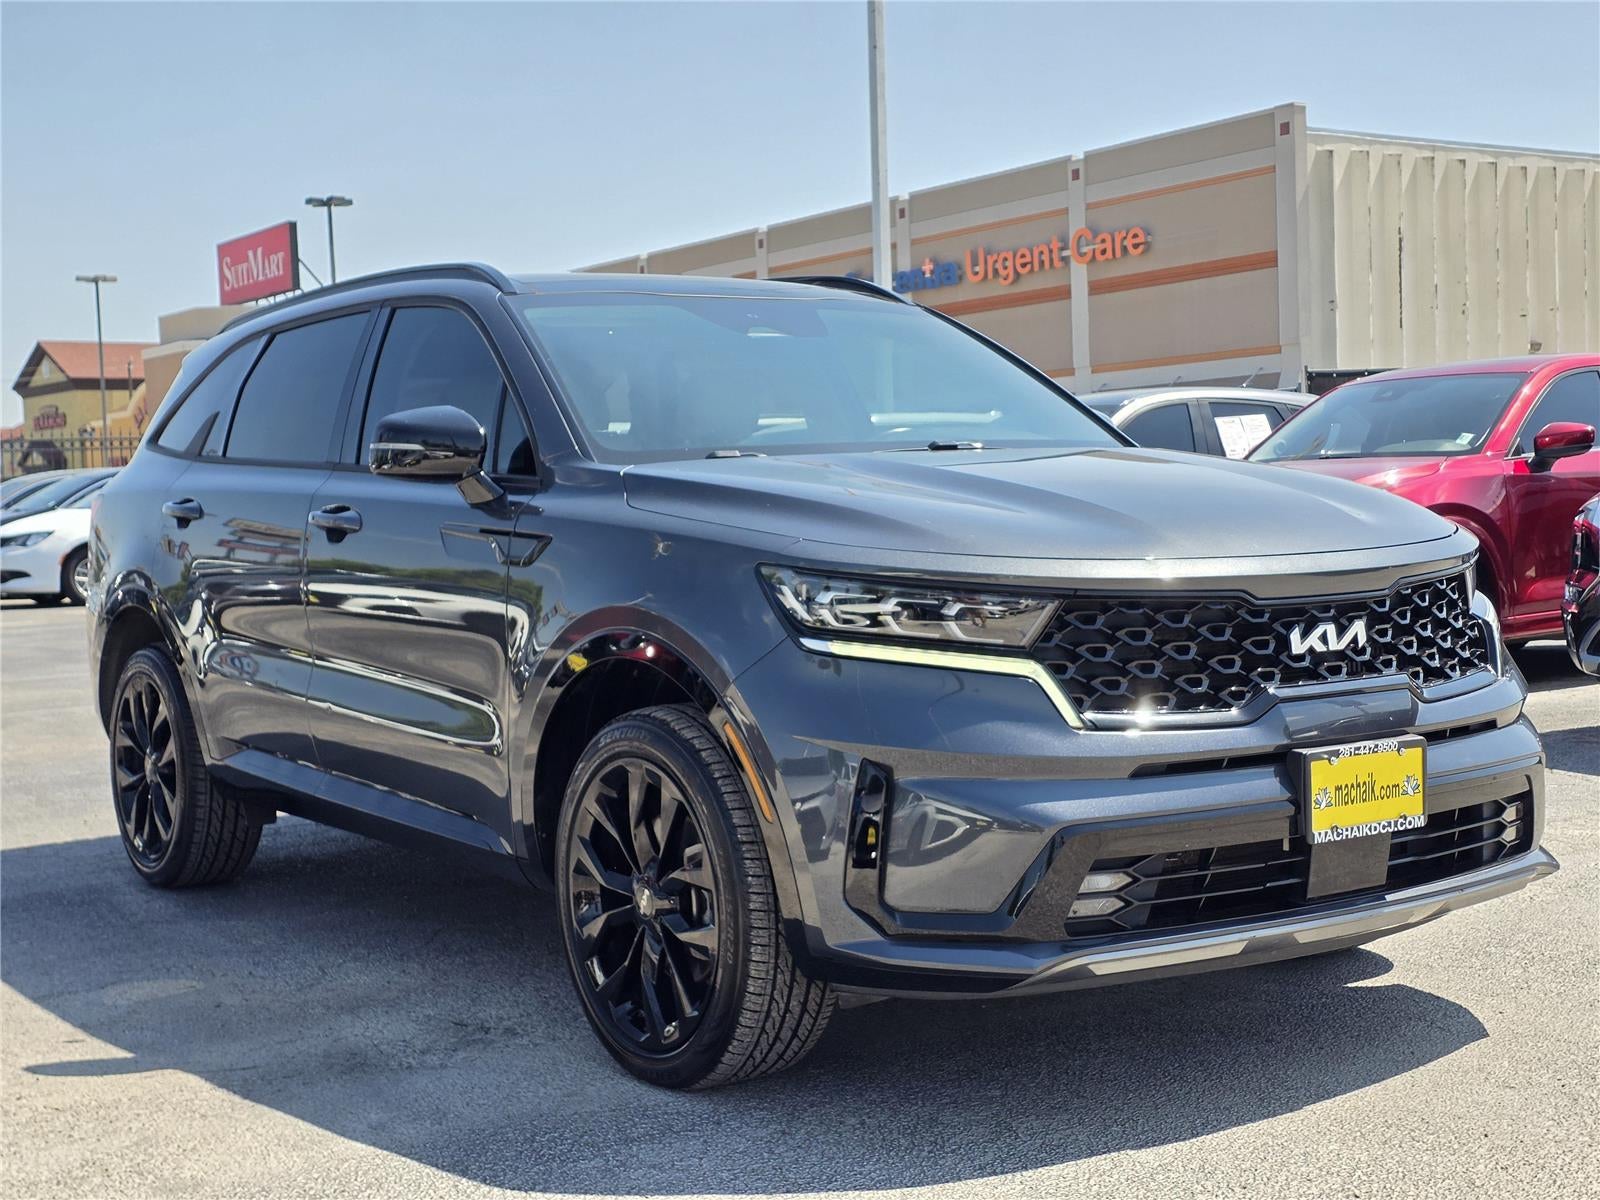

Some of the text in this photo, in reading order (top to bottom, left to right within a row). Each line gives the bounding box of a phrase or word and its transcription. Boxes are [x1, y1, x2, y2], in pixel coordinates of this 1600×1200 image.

[964, 235, 1062, 286] Urgent
[1070, 226, 1147, 265] Care
[1339, 741, 1399, 758] 281-447-9500
[1334, 774, 1400, 808] machaik.com
[1314, 815, 1425, 844] MACHAIKDCJ.COM
